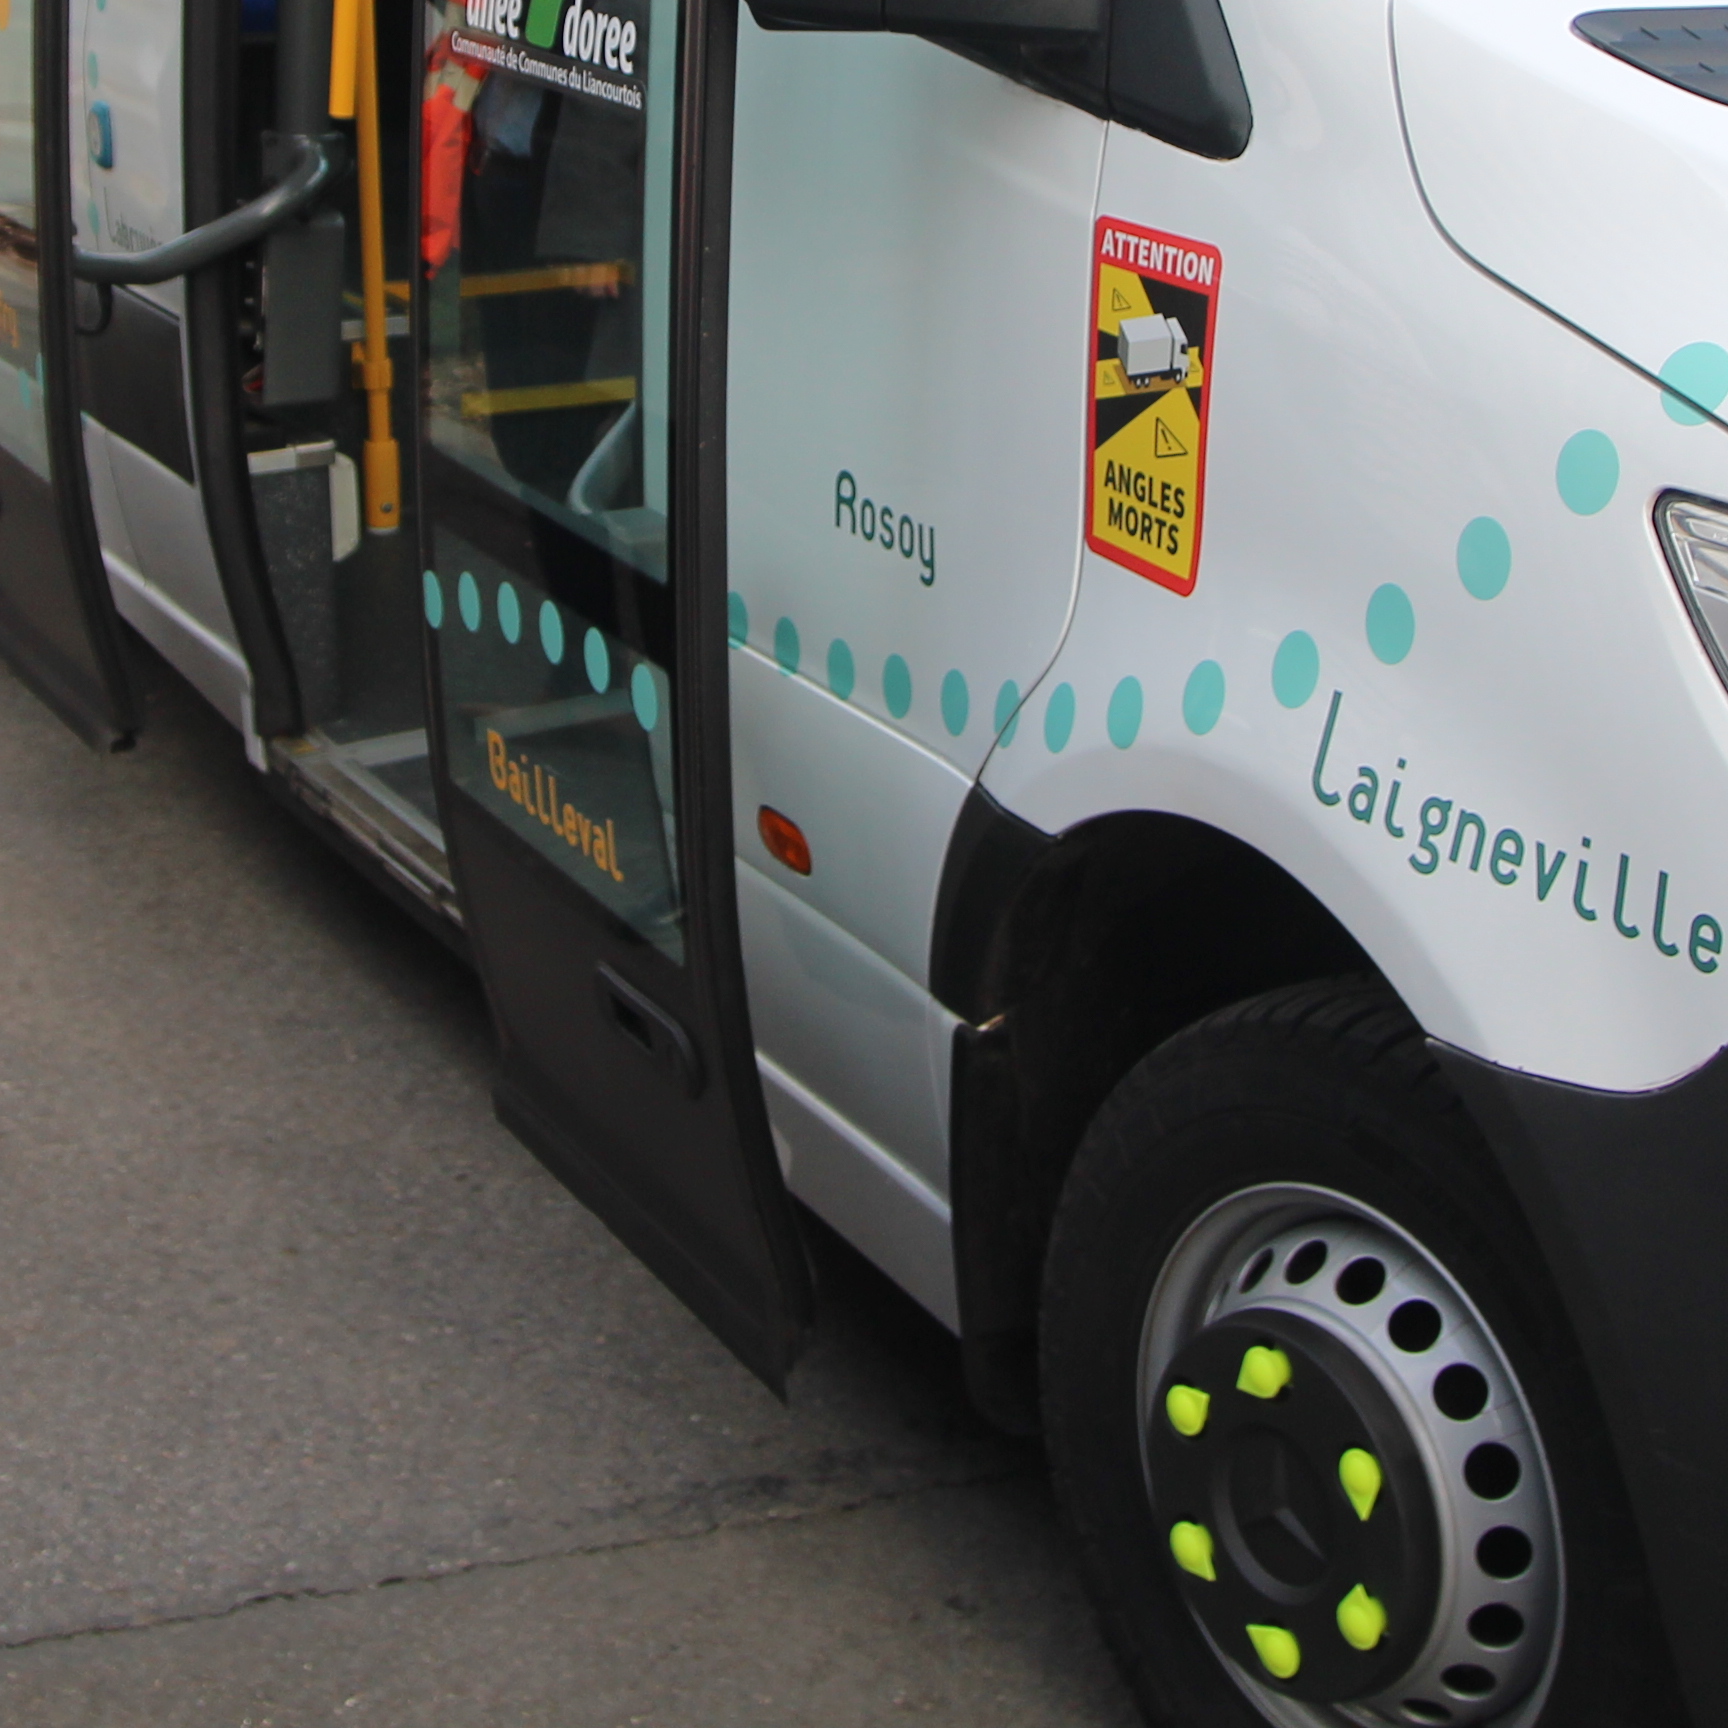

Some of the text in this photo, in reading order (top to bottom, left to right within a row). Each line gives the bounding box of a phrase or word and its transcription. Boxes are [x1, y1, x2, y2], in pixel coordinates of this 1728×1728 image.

[451, 30, 642, 110] Communauté de Communes du Liancourtois
[1100, 228, 1216, 286] ATTENTION
[834, 469, 935, 587] Rosoy
[1104, 459, 1186, 520] ANGLES
[1107, 496, 1180, 556] MORTS
[486, 727, 625, 883] Bailleval
[1312, 689, 1724, 974] Laigneville
